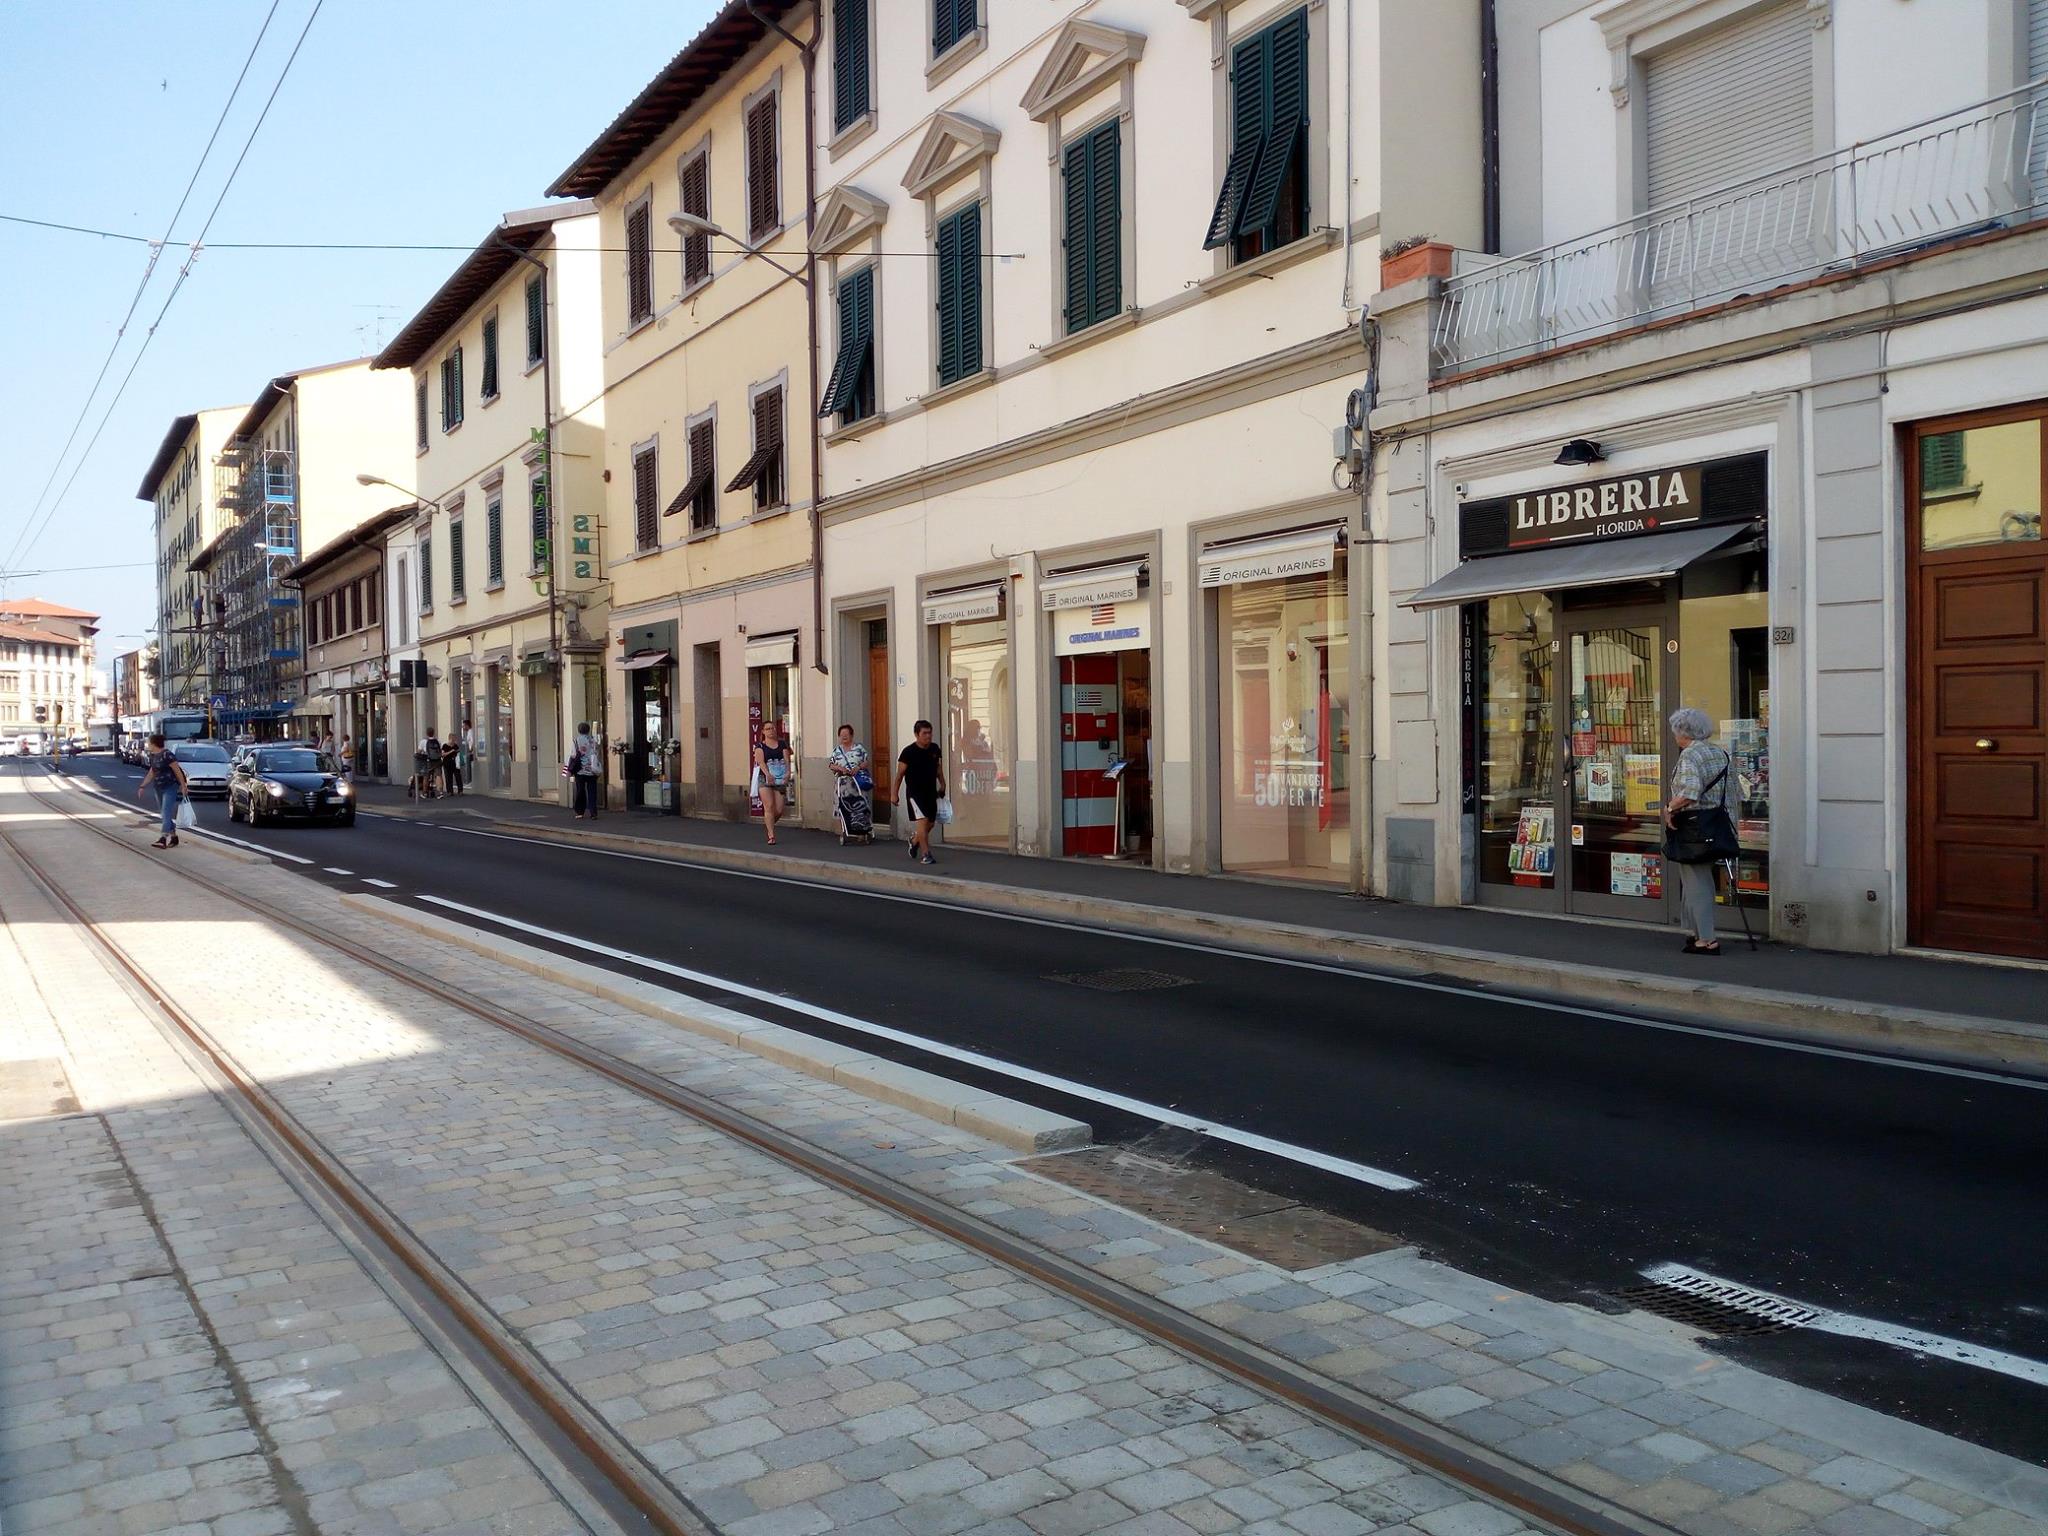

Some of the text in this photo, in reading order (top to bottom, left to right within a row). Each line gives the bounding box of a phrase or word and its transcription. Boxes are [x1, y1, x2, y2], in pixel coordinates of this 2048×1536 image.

[1516, 472, 1690, 529] LIBRERIA
[1596, 518, 1644, 536] FLORIDA
[1223, 558, 1326, 581] ORIGINAL MARINES
[1059, 589, 1133, 606] ORIGINAL MARINES
[938, 606, 994, 621] ORIGINAL MARINES
[1069, 627, 1140, 644] ORIGINAL MARINES
[1464, 614, 1472, 705] LIBRERIA
[1254, 772, 1280, 807] 50
[1280, 773, 1325, 787] VANTAGGI
[1280, 787, 1325, 807] PER TE
